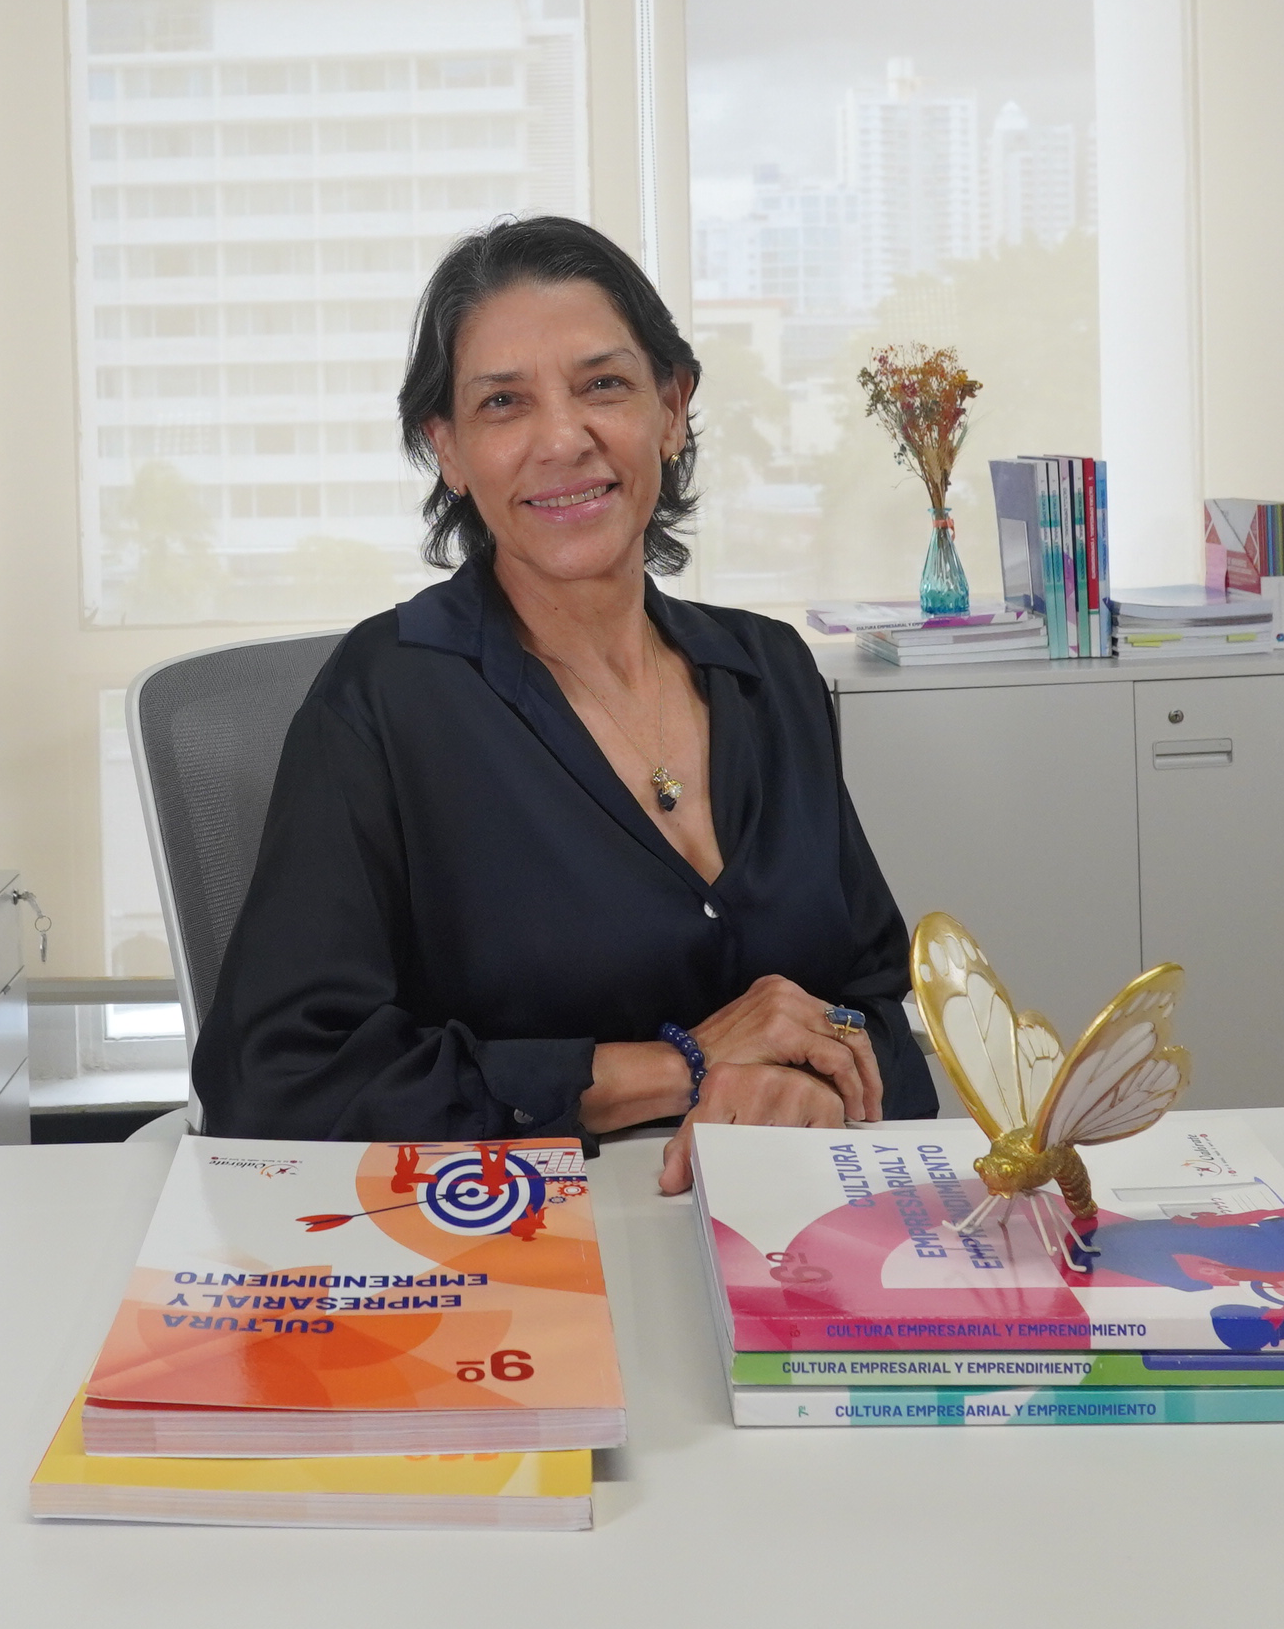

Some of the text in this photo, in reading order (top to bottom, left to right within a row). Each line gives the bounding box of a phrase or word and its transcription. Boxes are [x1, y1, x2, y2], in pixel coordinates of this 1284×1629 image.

[829, 1144, 876, 1208] CULTURA
[872, 1144, 948, 1258] EMPRESARIAL Y
[917, 1144, 1004, 1269] EMPRNDIMIENTO
[174, 1271, 489, 1289] EMPRENDIMIENTO
[166, 1293, 462, 1311] EMPRESARIAL Y
[162, 1314, 335, 1334] CULTURA
[826, 1324, 894, 1338] CULTURA
[897, 1324, 1001, 1338] EMPRESARIAL
[1005, 1324, 1014, 1337] Y
[1018, 1323, 1147, 1337] EMPRENDIMIENTO
[782, 1361, 1093, 1375] CULTURA EMPRESARIAL Y EMPRENDIMIENTO
[835, 1404, 903, 1418] CULTURA
[906, 1404, 1011, 1417] EMPRESARIAL
[1014, 1404, 1024, 1417] Y
[1027, 1403, 1157, 1417] EMPRENDIMIENTO
